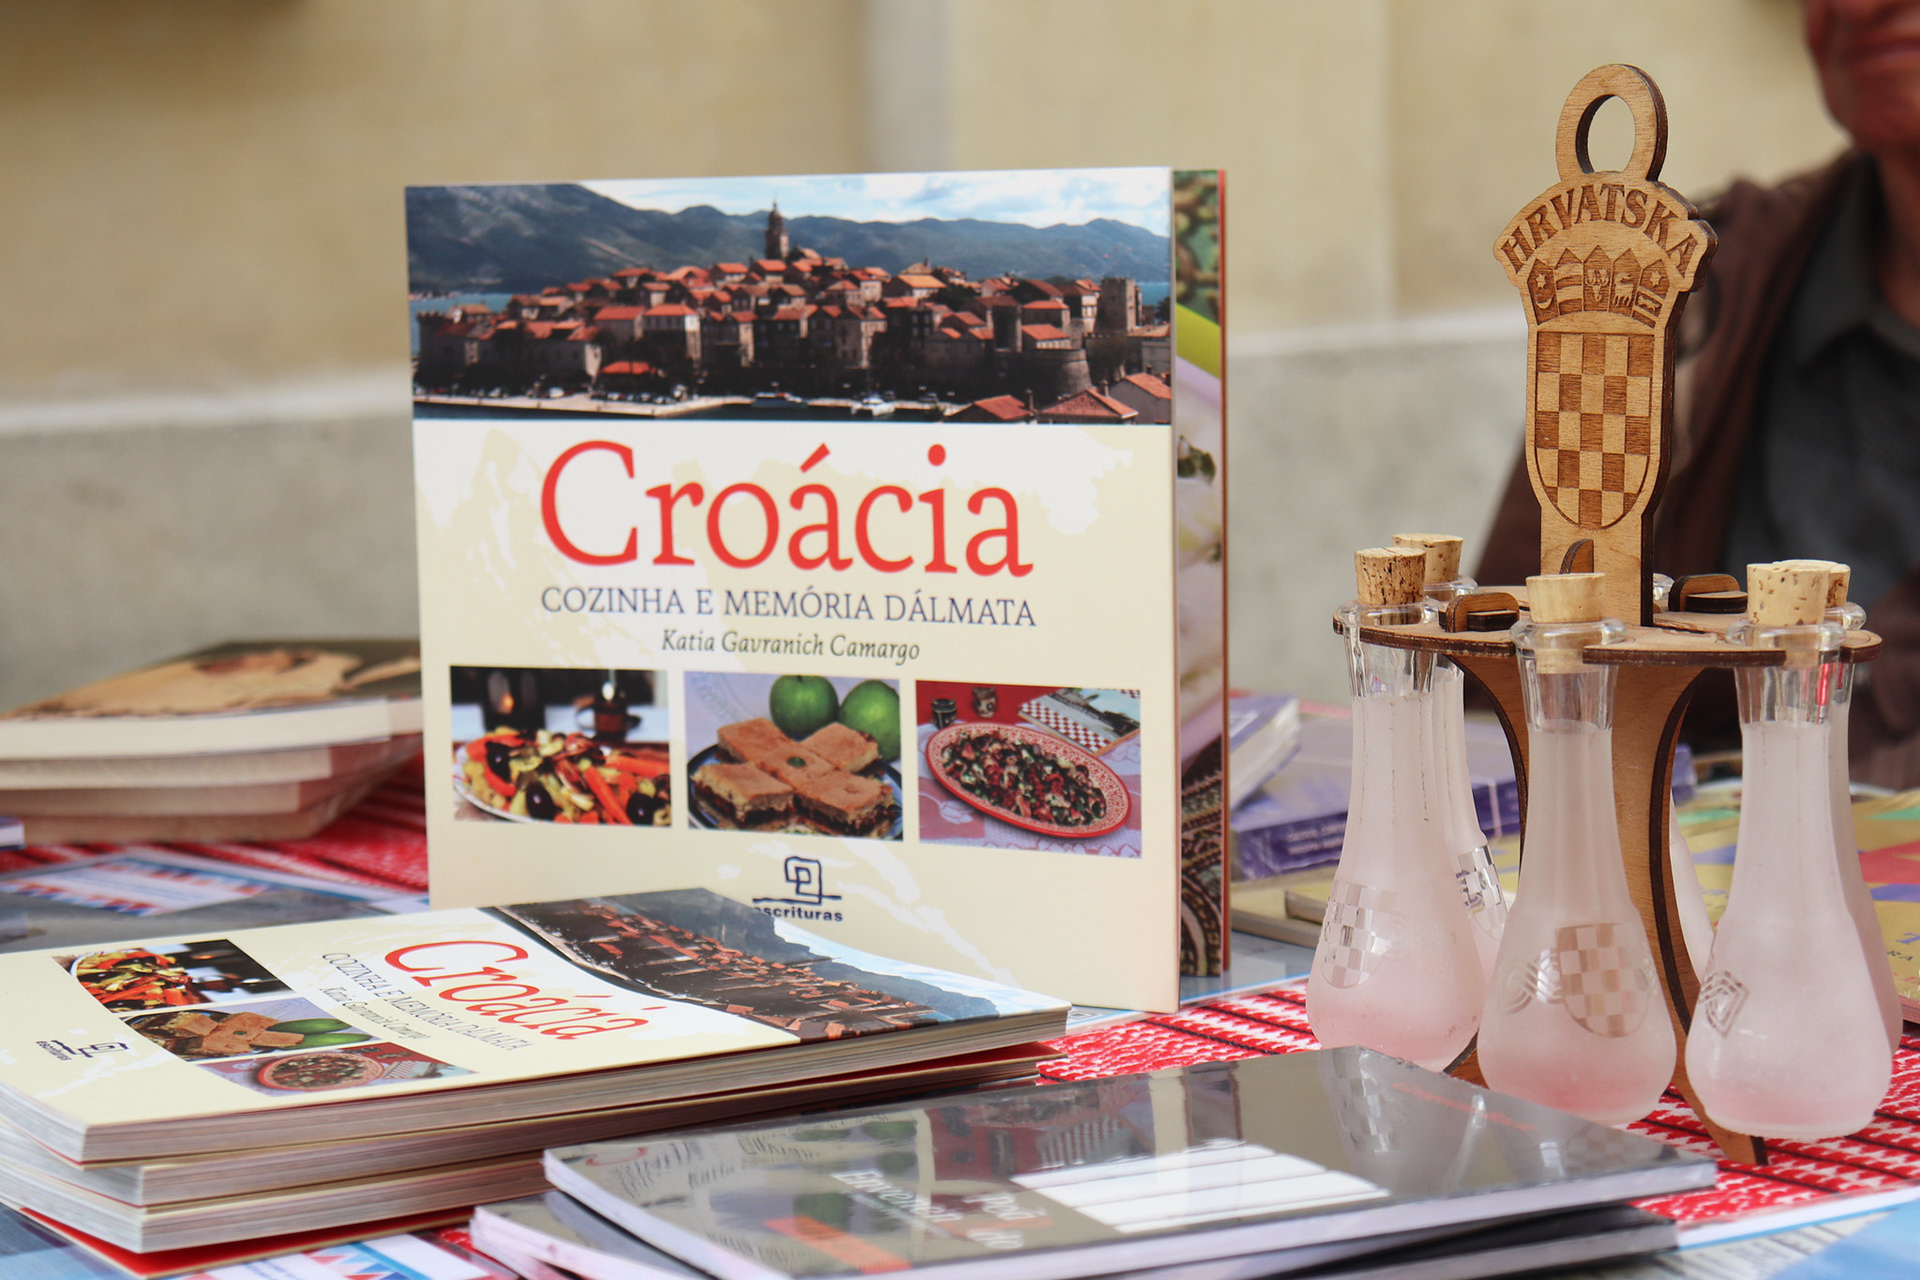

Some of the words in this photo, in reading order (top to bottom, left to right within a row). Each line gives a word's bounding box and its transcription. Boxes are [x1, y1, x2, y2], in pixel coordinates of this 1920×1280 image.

[1500, 183, 1699, 279] HRVATSKA
[541, 439, 1034, 577] Croácia
[541, 587, 685, 614] COZINHA
[696, 588, 714, 615] E
[724, 584, 874, 622] MEMÓRIA
[884, 588, 1037, 628] DÁLMATA
[662, 628, 715, 653] Katia
[721, 630, 824, 657] Gavranich
[829, 634, 921, 667] Camargo
[385, 940, 668, 1040] Croácia
